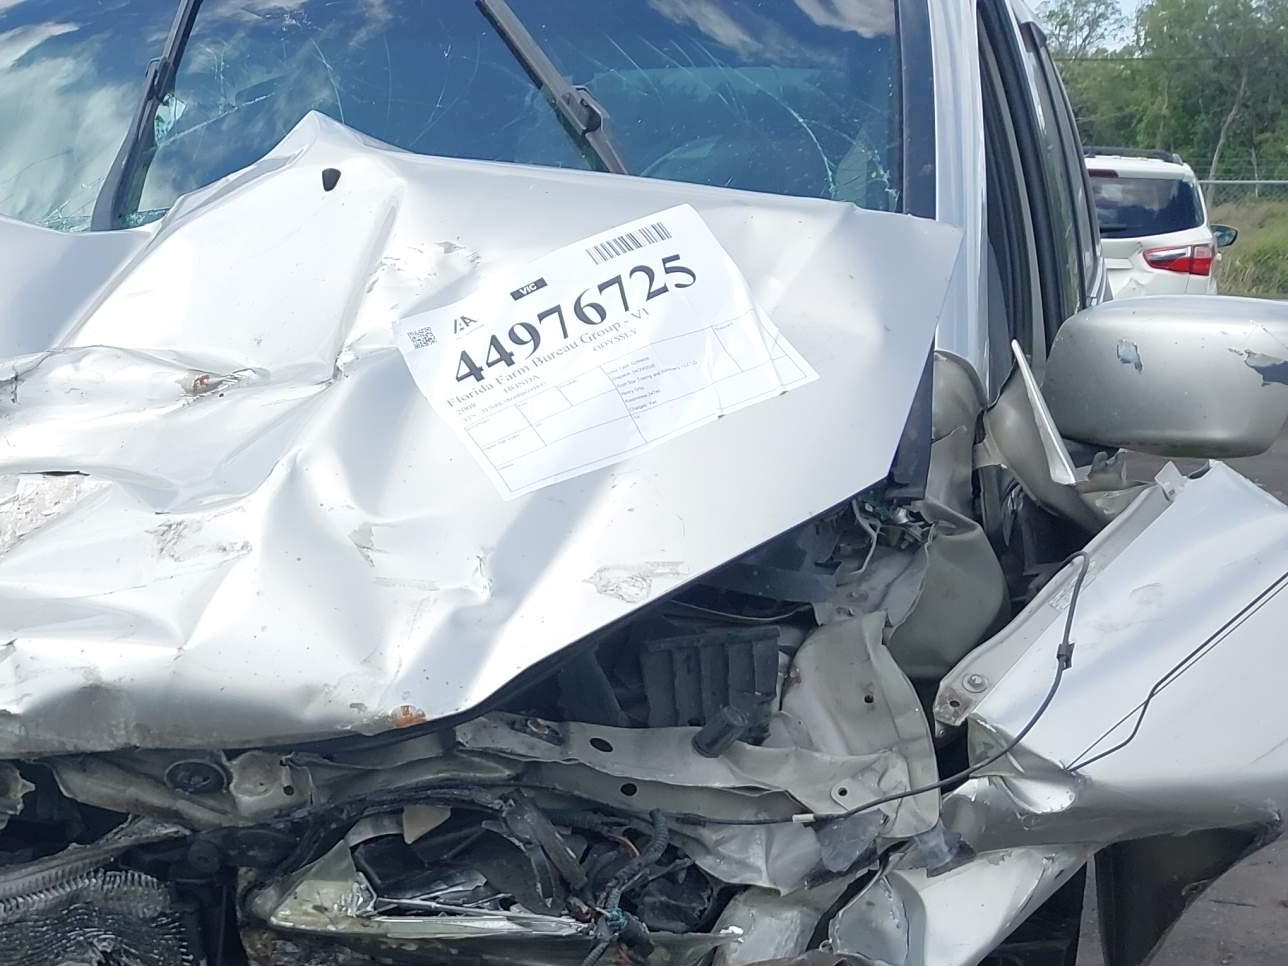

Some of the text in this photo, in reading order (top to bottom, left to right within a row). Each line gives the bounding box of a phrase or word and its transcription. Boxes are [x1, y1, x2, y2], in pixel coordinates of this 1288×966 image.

[519, 282, 538, 295] VIC
[455, 253, 697, 383] 44976725
[592, 327, 638, 352] ODYSSEY
[446, 382, 495, 408] Florida
[495, 365, 531, 385] Farm
[531, 340, 579, 368] Bureau
[579, 320, 621, 344] Group
